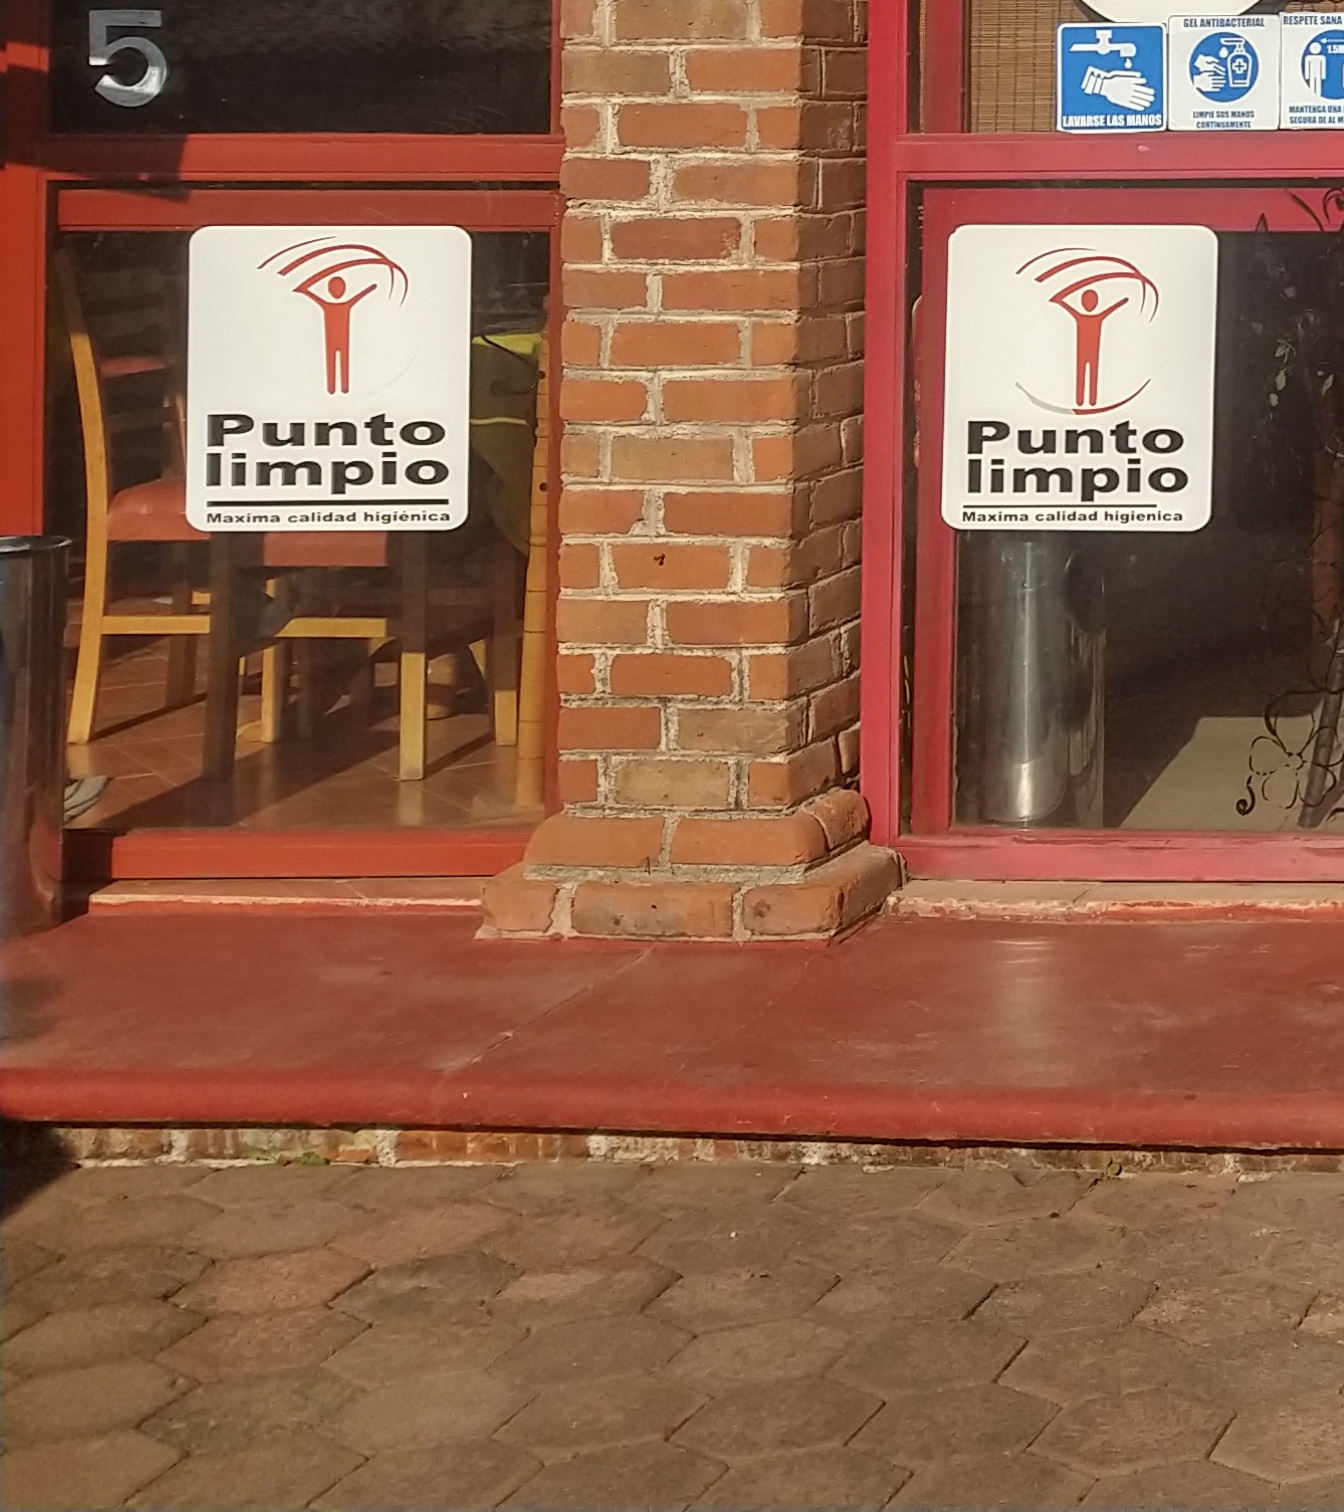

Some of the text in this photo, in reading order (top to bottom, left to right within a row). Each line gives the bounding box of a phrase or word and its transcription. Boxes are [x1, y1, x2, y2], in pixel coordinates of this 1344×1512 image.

[1183, 18, 1265, 28] GEL ANTIBACTERIAL
[1283, 16, 1318, 25] RESPETE
[1320, 16, 1342, 25] SANA
[88, 9, 168, 107] 5
[1193, 110, 1255, 119] LIMPIE SUS MANOS
[1289, 105, 1326, 113] MANTENGA
[1327, 105, 1341, 113] UNA
[1062, 114, 1162, 128] LAVARSE LAS MANOS
[206, 413, 446, 447] Punto
[966, 420, 1185, 455] Punto
[206, 452, 450, 495] limpio
[966, 458, 1189, 502] limpio
[206, 512, 280, 524] Maxima
[287, 511, 356, 524] calidad
[962, 511, 1029, 522] Maxima
[1035, 510, 1098, 522] calidad
